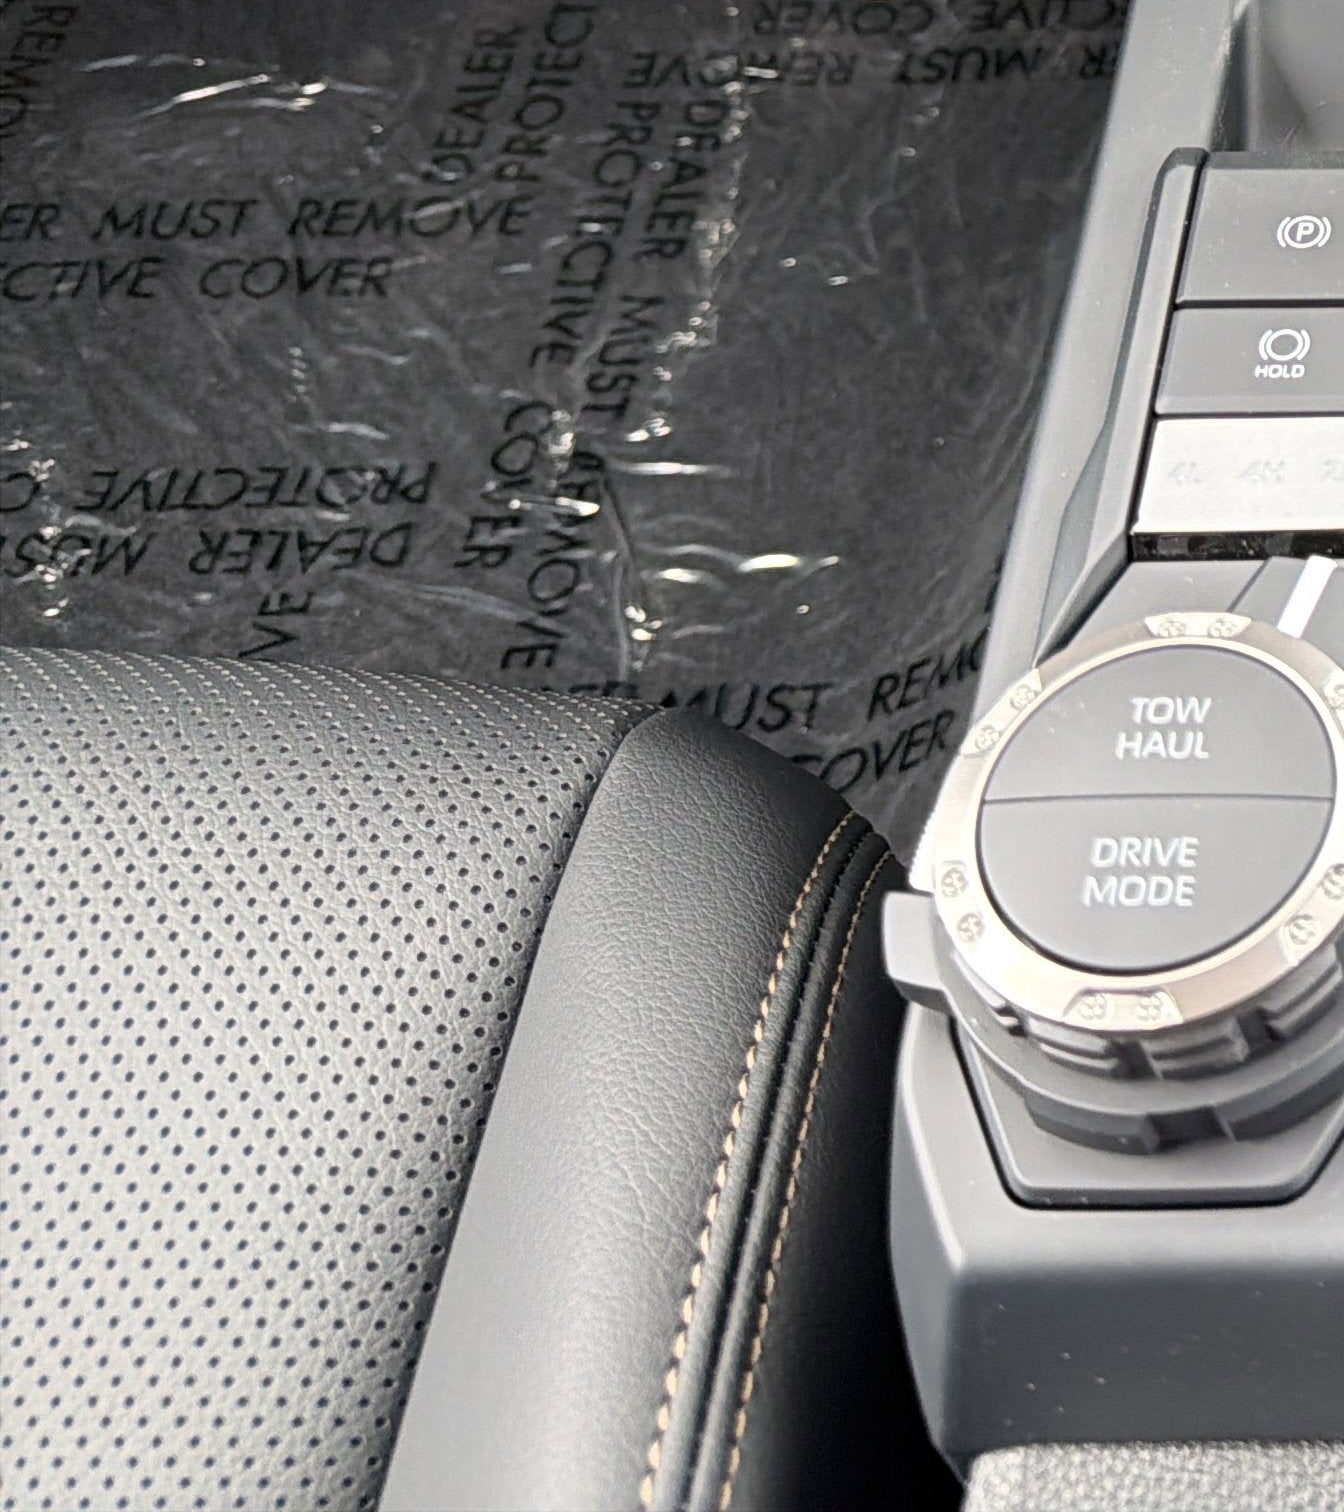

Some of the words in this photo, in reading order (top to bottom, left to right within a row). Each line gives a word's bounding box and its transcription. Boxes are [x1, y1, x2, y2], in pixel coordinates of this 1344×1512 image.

[93, 198, 260, 240] MUST
[288, 194, 536, 240] REMOVE
[200, 256, 392, 300] COVER
[1254, 364, 1305, 378] HOLD
[73, 461, 440, 513] PROTECTIVE
[188, 520, 416, 576] DEALER
[1131, 696, 1213, 724] TOW
[1115, 731, 1210, 759] HAUL
[1091, 836, 1199, 867] DRIVE
[1083, 875, 1196, 907] MODE
